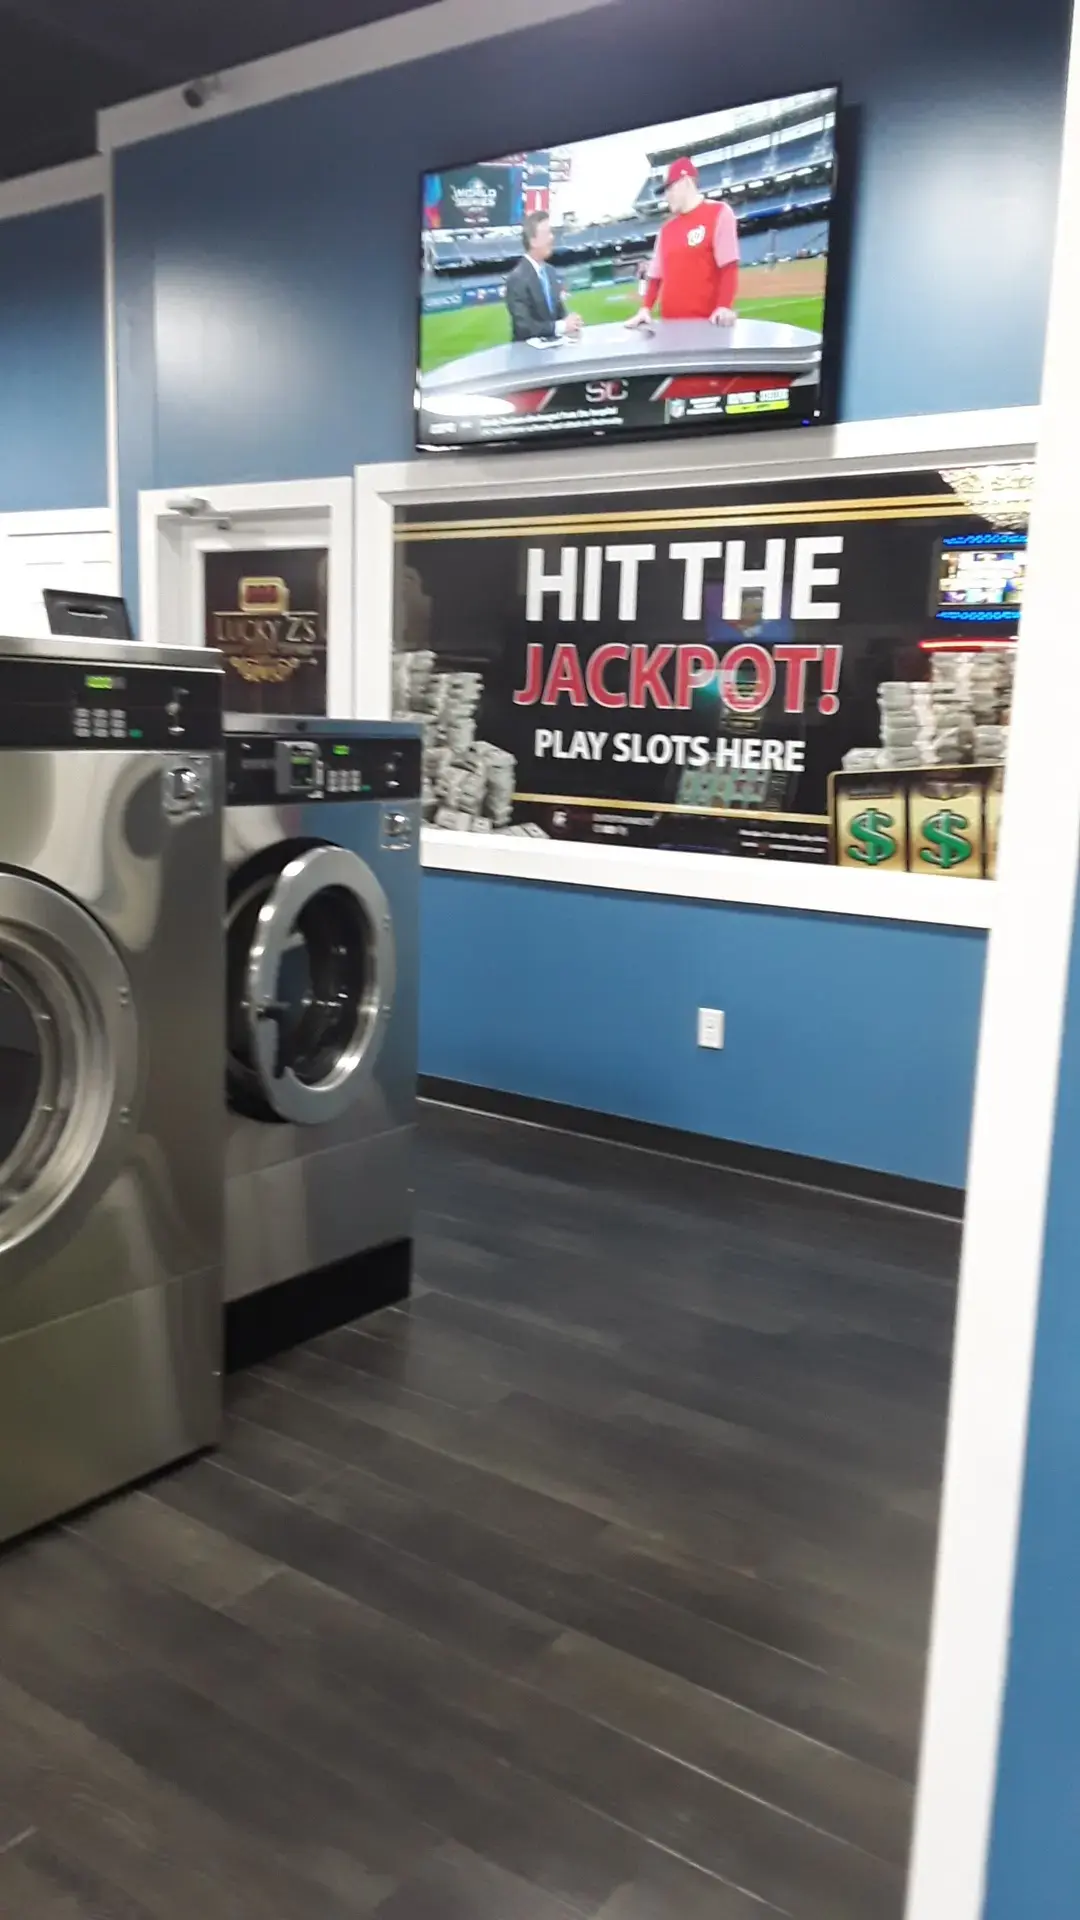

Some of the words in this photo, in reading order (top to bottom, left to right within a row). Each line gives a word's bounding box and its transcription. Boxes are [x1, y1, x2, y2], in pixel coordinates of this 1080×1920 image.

[585, 379, 629, 402] SC
[525, 544, 656, 622] HIT
[669, 536, 844, 621] THE
[214, 617, 279, 648] LUCKY
[512, 642, 843, 716] JACKPOT!
[534, 728, 609, 760] PLAY
[612, 732, 710, 767] SLOTS
[716, 737, 806, 772] HERE
